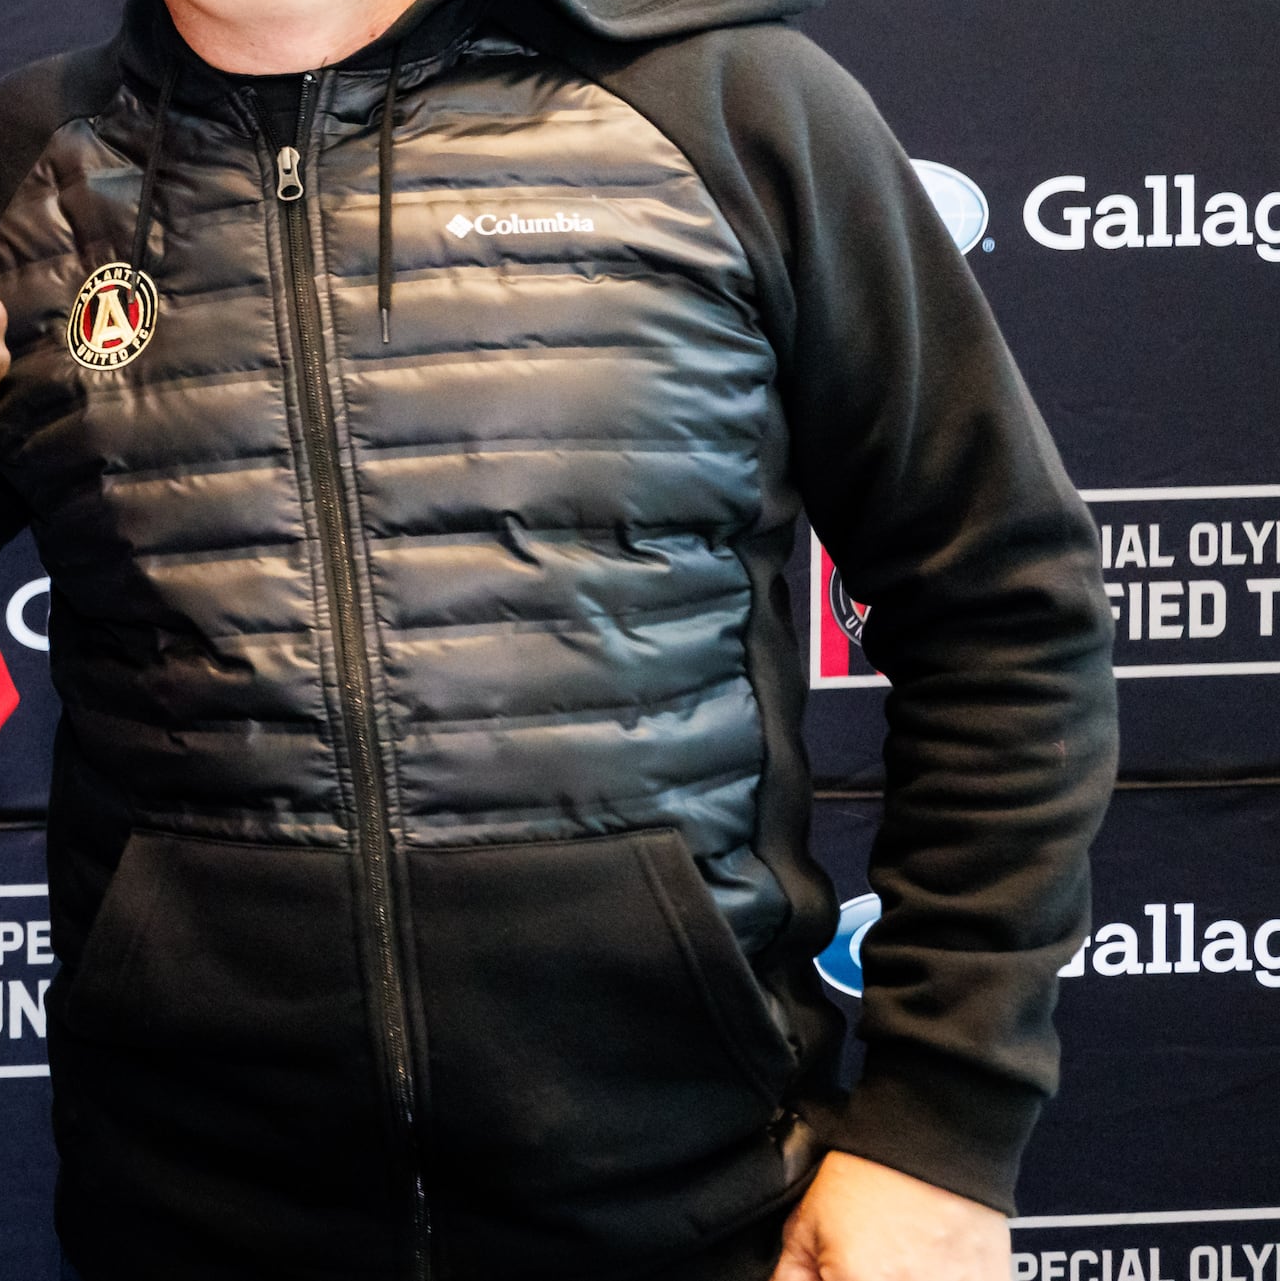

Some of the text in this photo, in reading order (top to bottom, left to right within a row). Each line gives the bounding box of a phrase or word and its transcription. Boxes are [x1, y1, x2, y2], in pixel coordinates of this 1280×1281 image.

[474, 211, 595, 236] Columbia
[76, 343, 129, 366] UNITED
[1011, 1247, 1176, 1281] PECIAL
